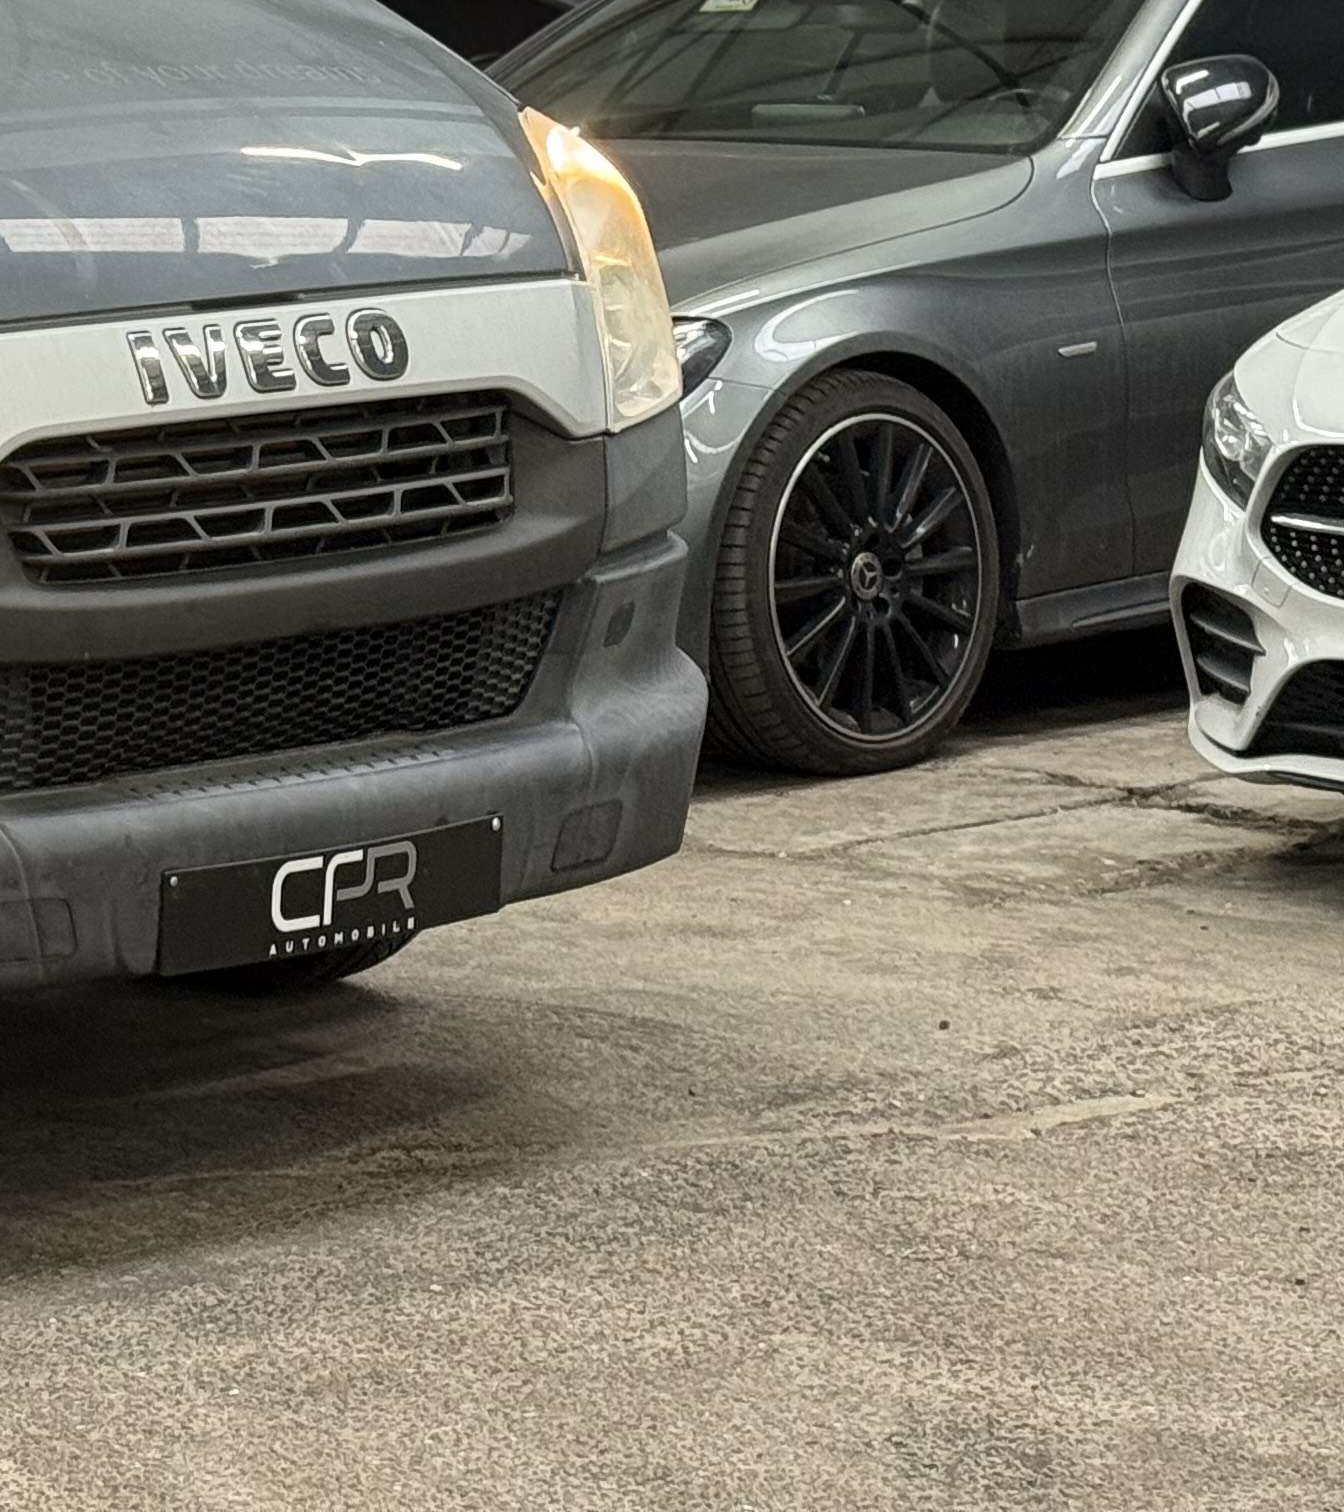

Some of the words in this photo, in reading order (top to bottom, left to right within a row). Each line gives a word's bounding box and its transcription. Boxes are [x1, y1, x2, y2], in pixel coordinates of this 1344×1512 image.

[131, 63, 227, 88] your
[126, 308, 409, 405] IVECO
[272, 841, 417, 932] CPR
